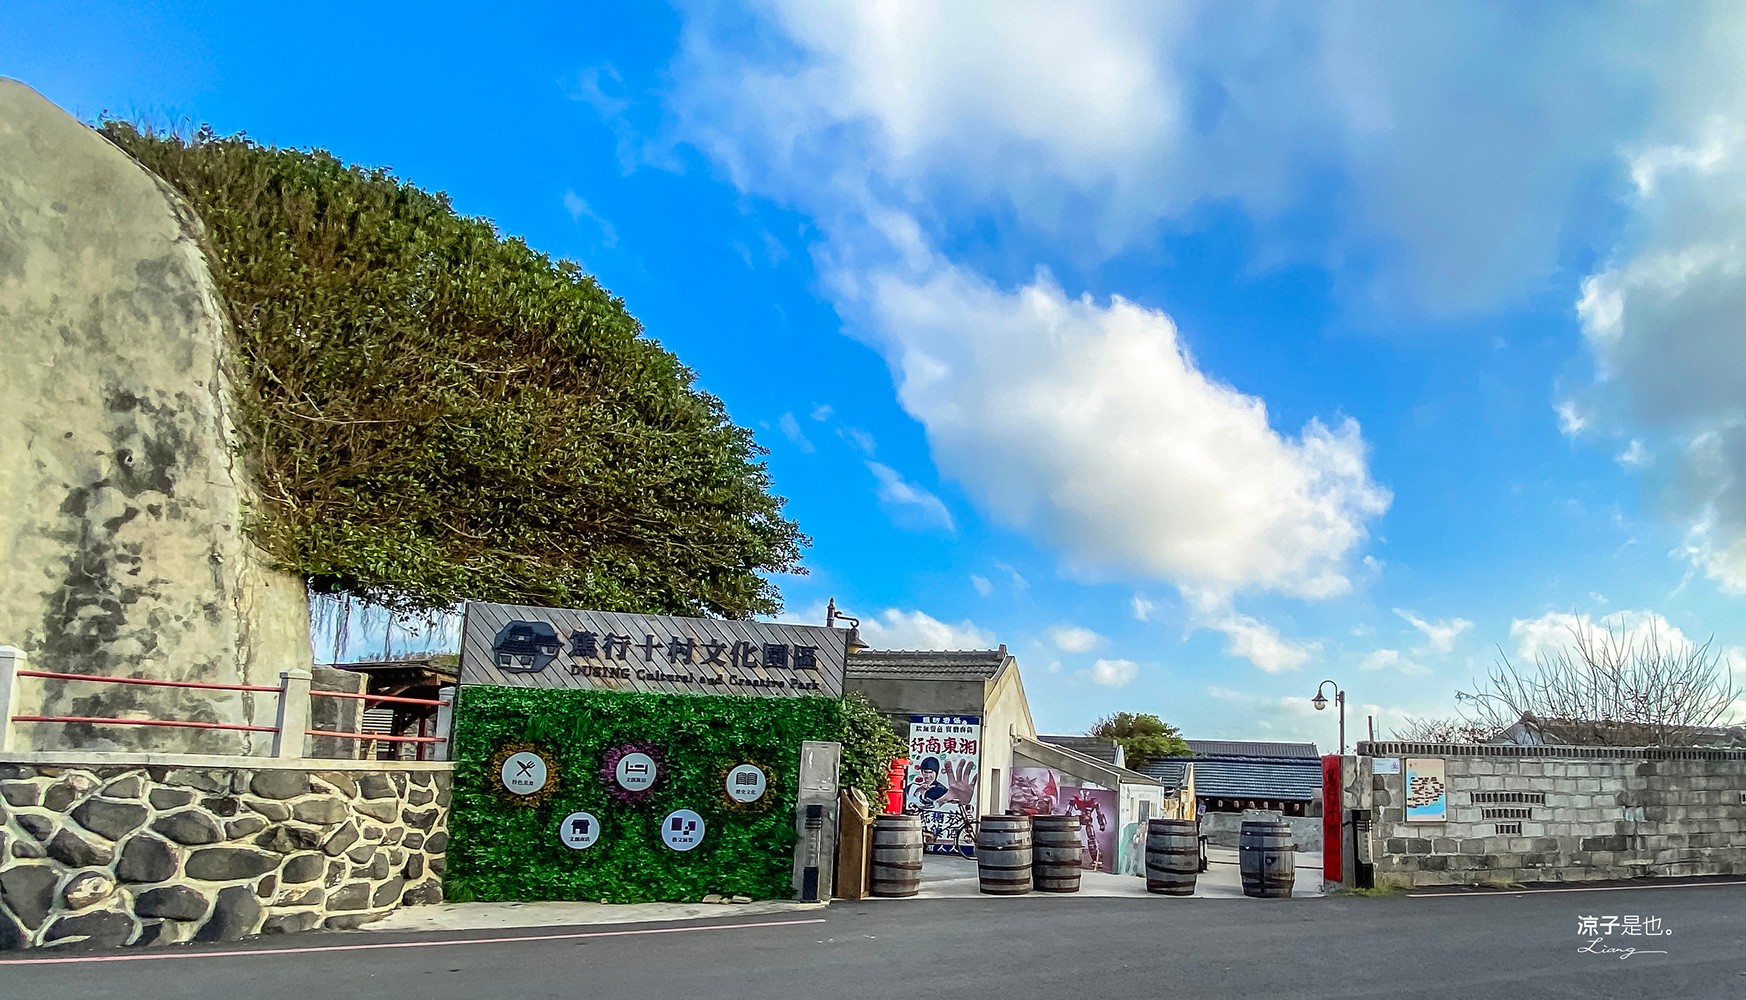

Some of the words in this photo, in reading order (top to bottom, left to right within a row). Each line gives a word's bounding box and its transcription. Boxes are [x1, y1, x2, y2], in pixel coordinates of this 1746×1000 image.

[569, 629, 820, 671] 篤行十村文化園區
[636, 668, 694, 684] Cultural
[699, 673, 724, 686] and
[728, 674, 786, 689] Creative
[790, 677, 821, 691] Park
